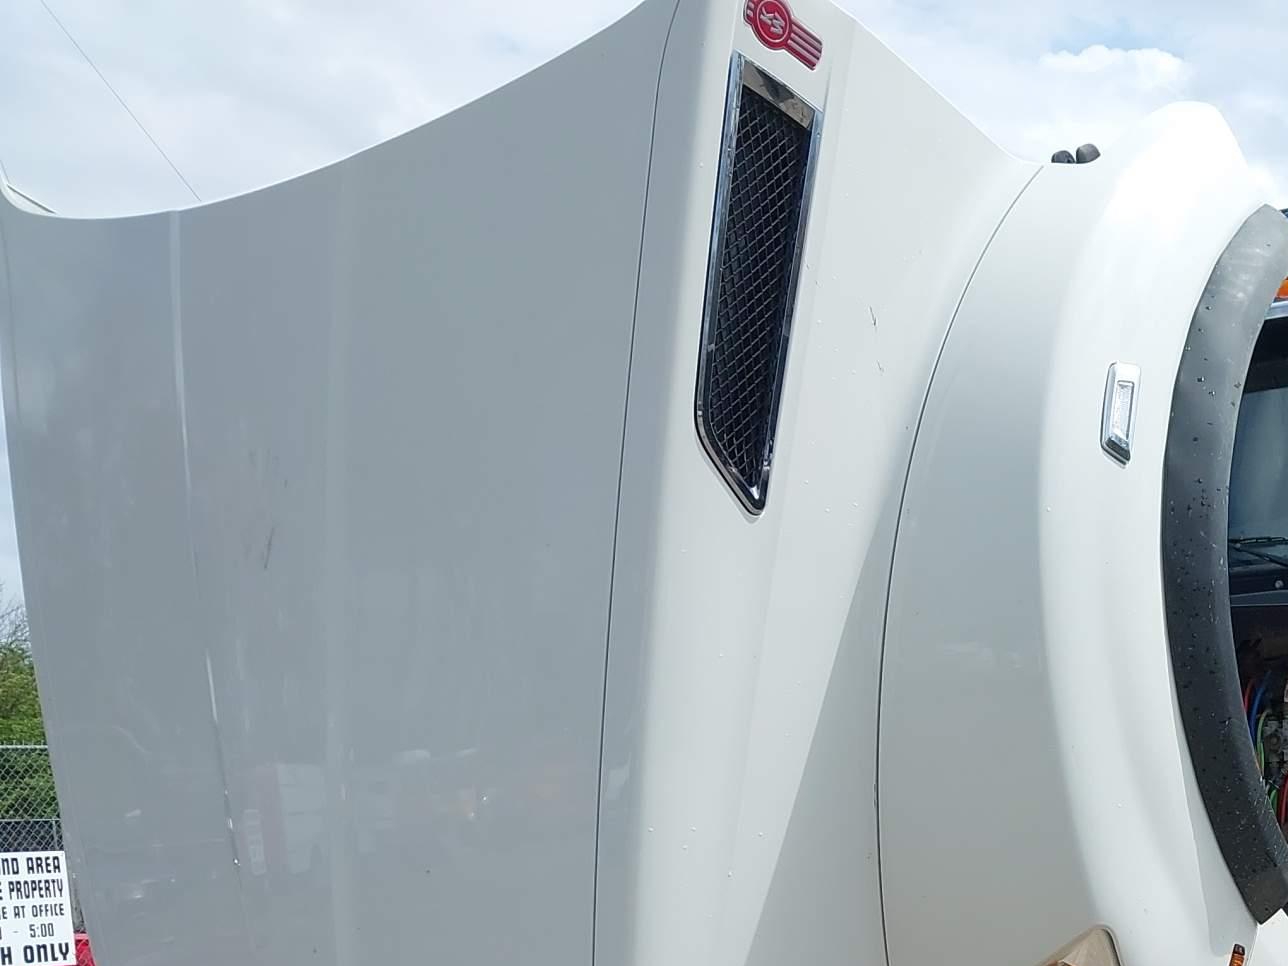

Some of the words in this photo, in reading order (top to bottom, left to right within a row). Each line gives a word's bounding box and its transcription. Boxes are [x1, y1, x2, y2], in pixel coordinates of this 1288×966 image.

[0, 857, 20, 875] ND
[26, 855, 61, 875] AREA
[8, 878, 63, 900] PROPERTY
[14, 905, 26, 919] AT
[31, 903, 65, 918] OFFICE
[29, 922, 55, 938] 5:00
[23, 942, 69, 964] ONLY
